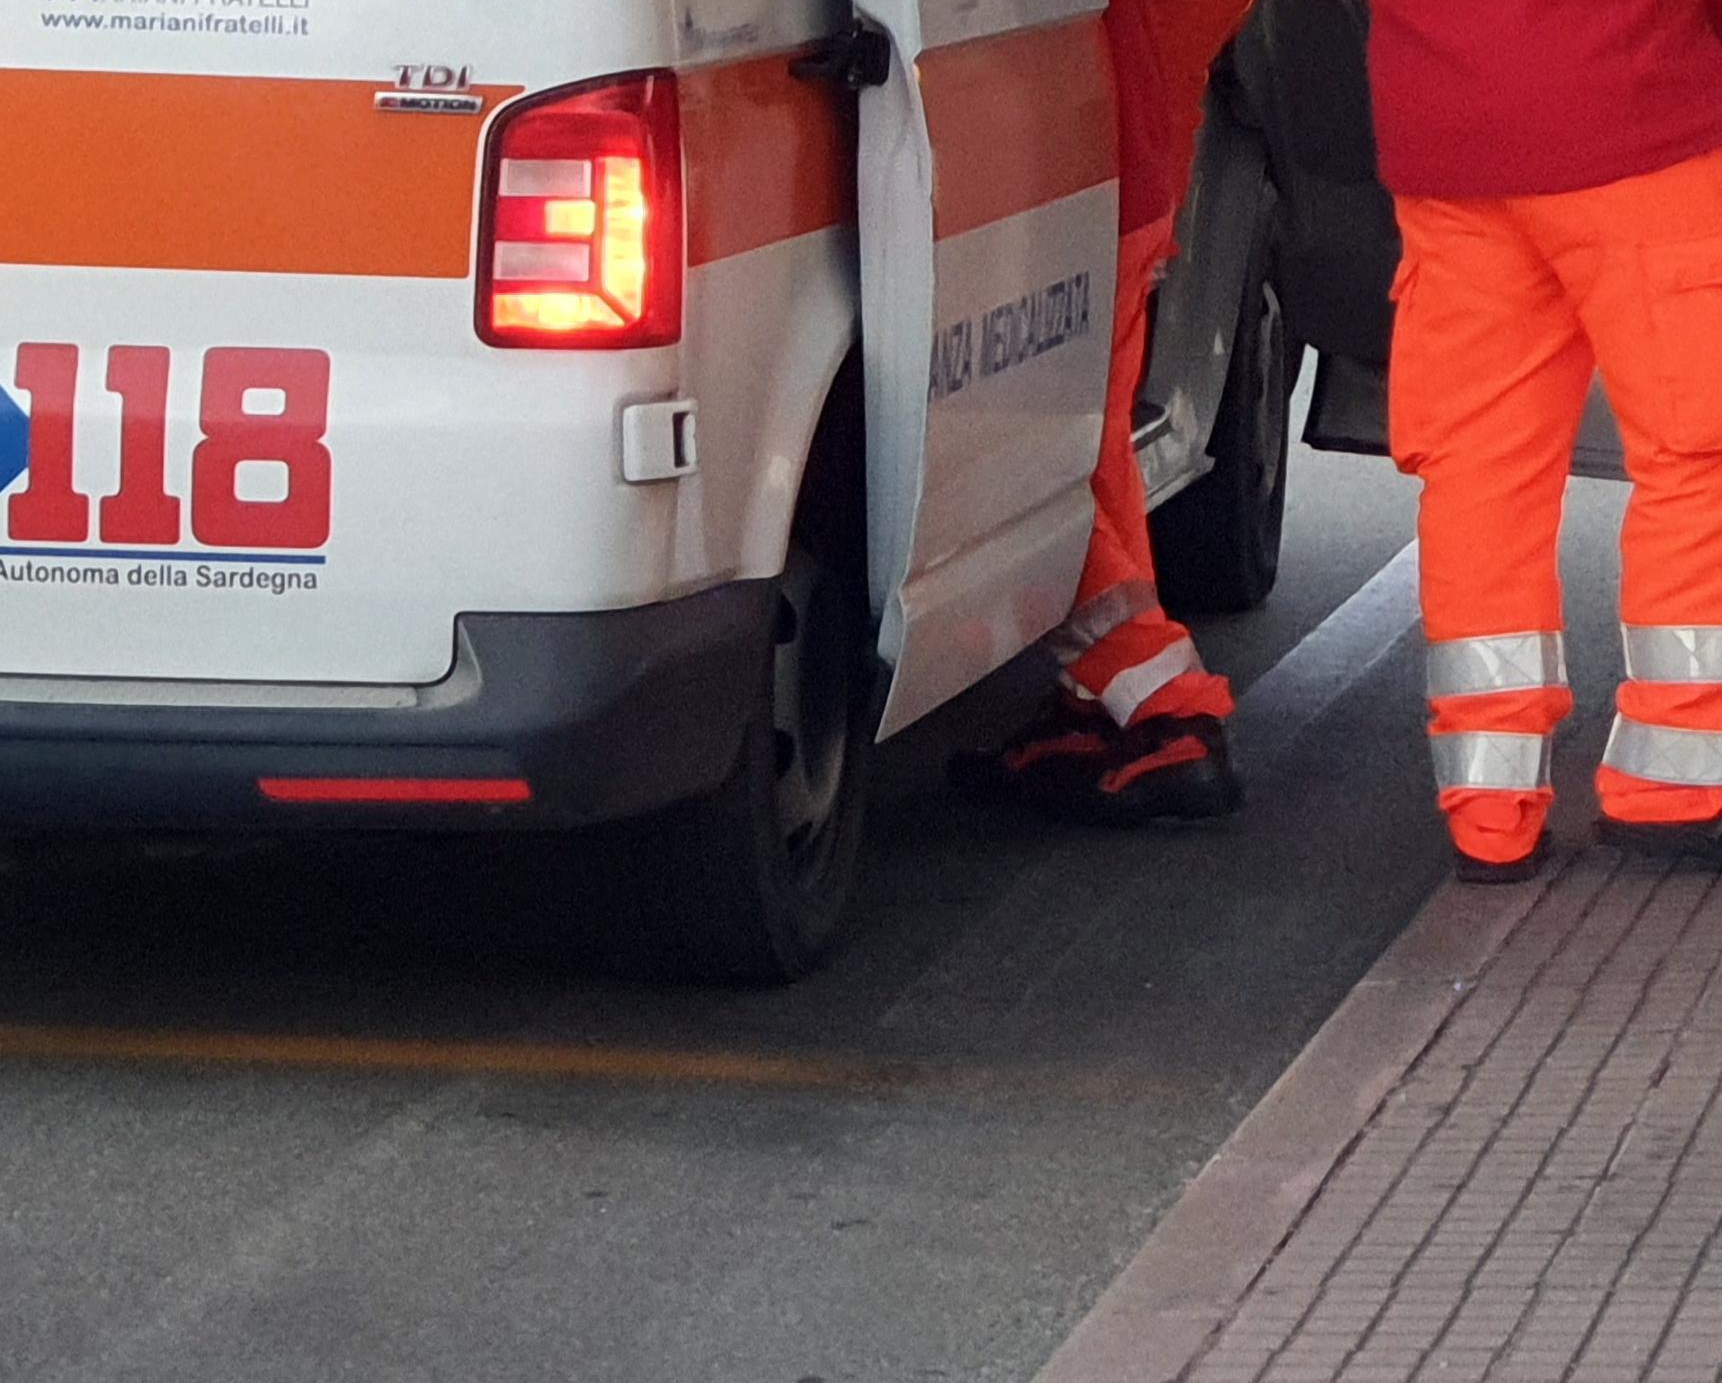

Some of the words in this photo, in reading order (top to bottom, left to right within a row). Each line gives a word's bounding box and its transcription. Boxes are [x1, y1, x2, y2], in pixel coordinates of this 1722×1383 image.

[41, 10, 310, 35] www.marianifratelli.it
[393, 63, 471, 90] TDI
[7, 342, 332, 549] 118
[127, 564, 188, 587] della
[195, 565, 318, 595] Sardegna
